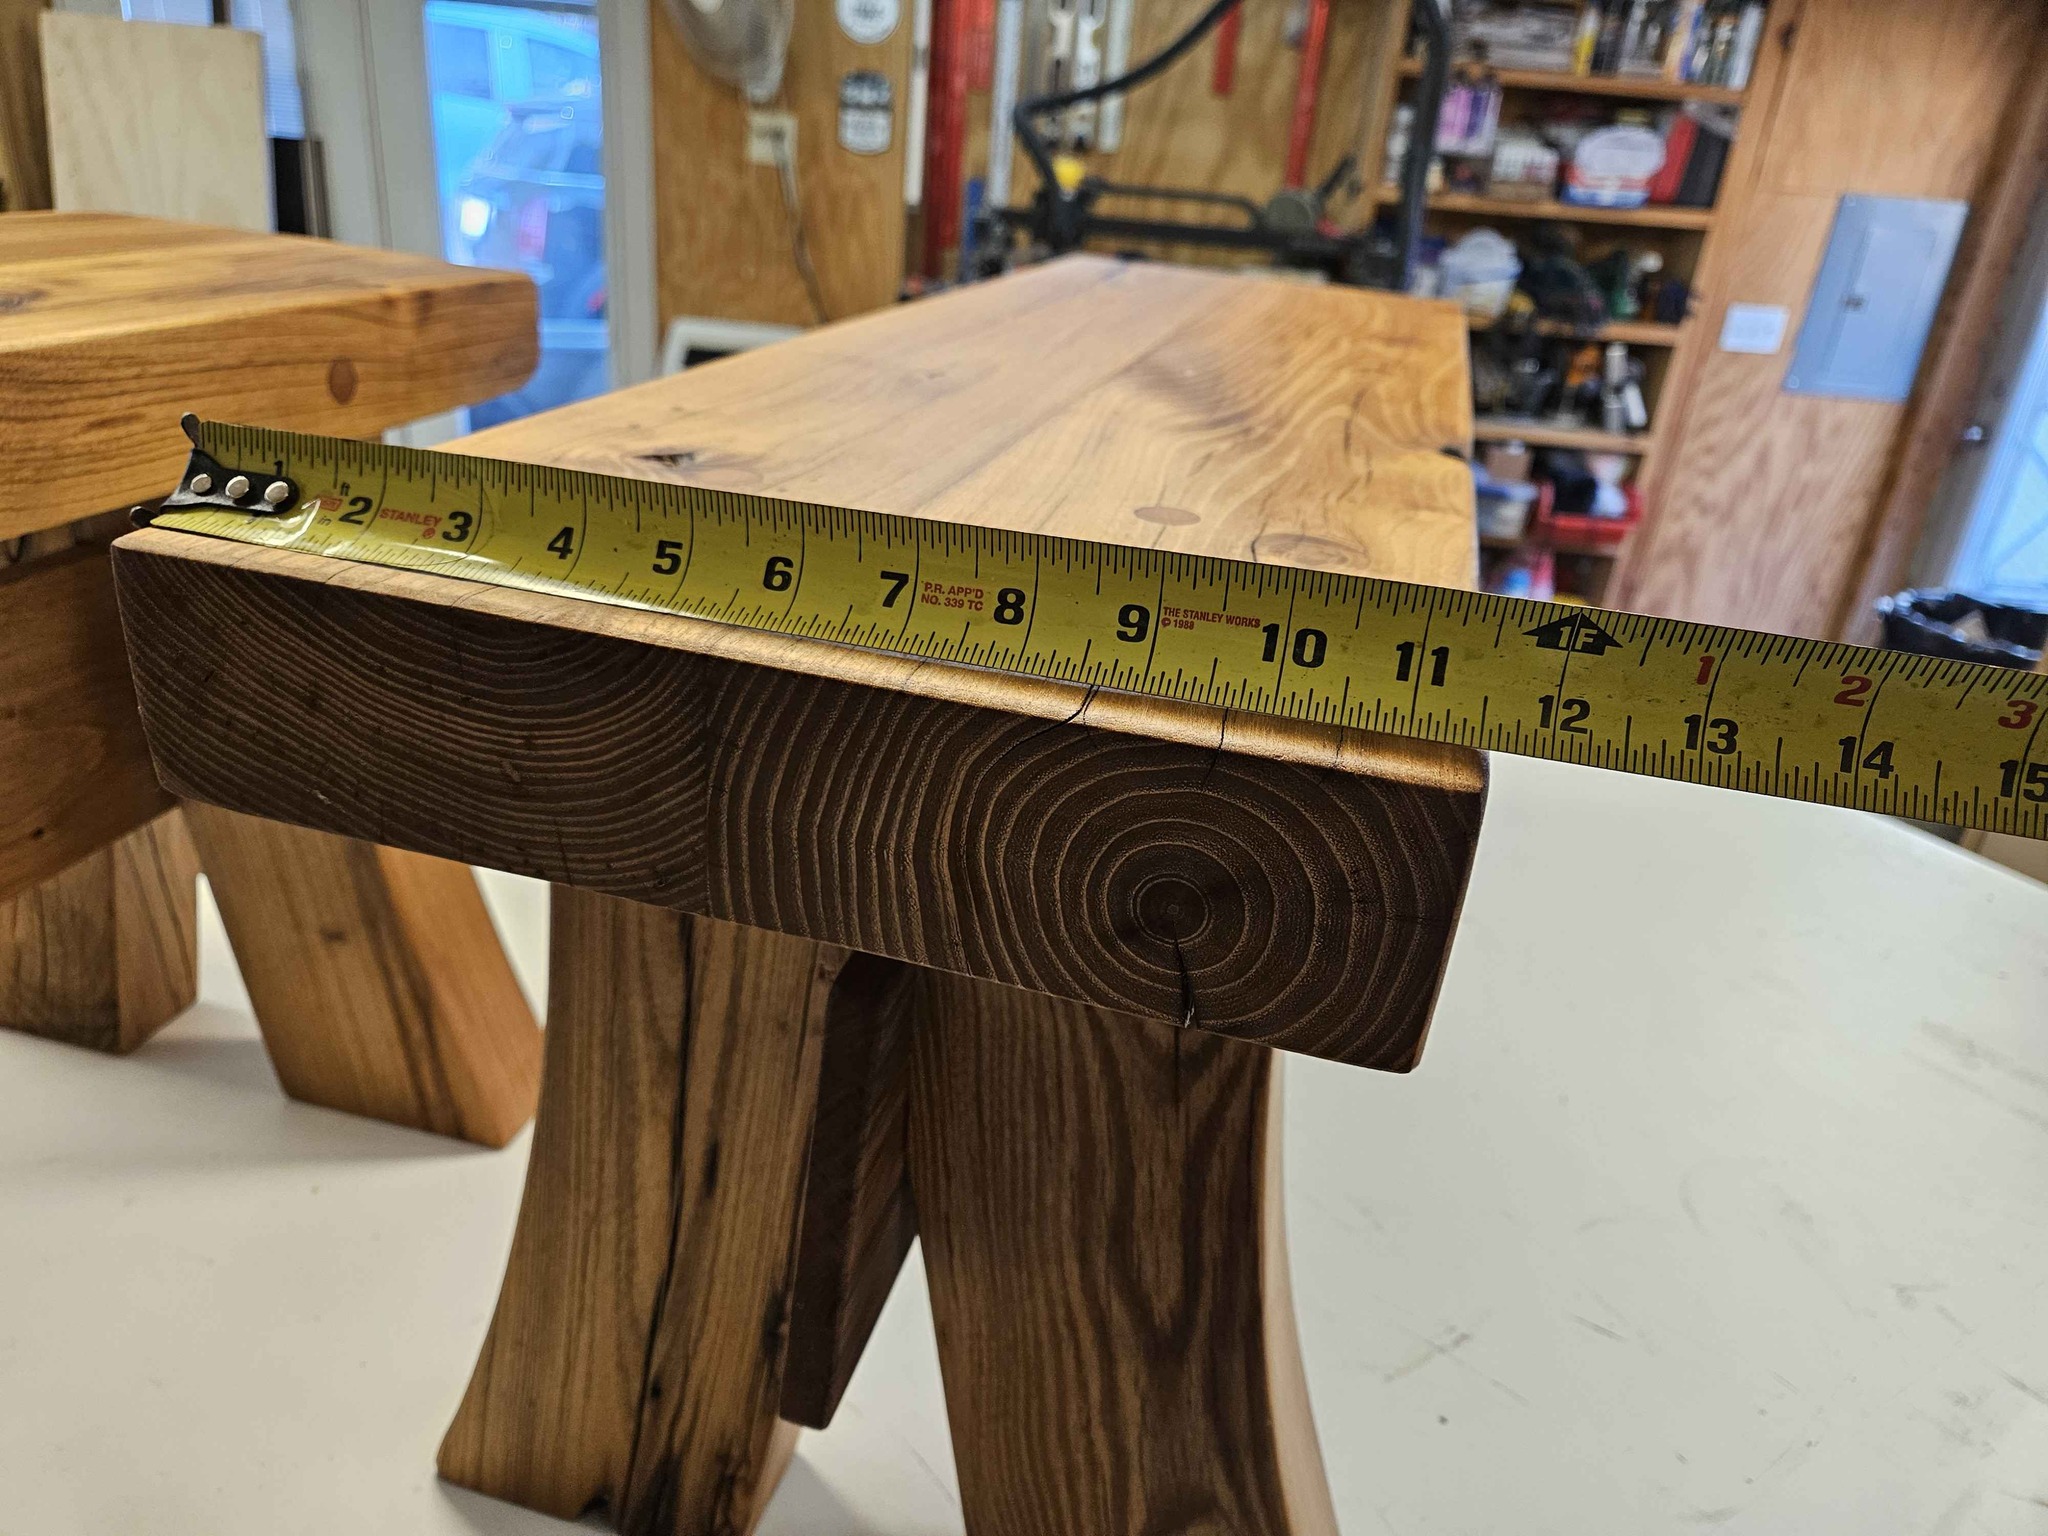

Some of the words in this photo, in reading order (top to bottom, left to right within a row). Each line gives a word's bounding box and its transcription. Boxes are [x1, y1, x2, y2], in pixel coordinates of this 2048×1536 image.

[338, 496, 374, 526] 2
[379, 508, 443, 527] STANLEY
[442, 511, 473, 543] 3
[546, 526, 575, 560] 4
[652, 539, 684, 576] 5
[762, 556, 794, 592] 6
[880, 570, 910, 608] 7
[924, 581, 945, 594] P.R.
[948, 585, 984, 599] APP'D
[921, 593, 941, 605] NO.
[944, 597, 965, 608] 339
[967, 600, 984, 611] TC
[993, 587, 1026, 626] 8
[1163, 606, 1181, 618] THE
[1182, 609, 1224, 623] STANLEY
[1225, 614, 1261, 629] WORKS
[1116, 603, 1151, 643] 9
[1173, 618, 1195, 630] 1988
[1558, 625, 1598, 650] 1F
[1262, 622, 1328, 669] 10
[1395, 640, 1450, 687] 11
[1696, 655, 1715, 685] 1
[1833, 675, 1873, 707] 2
[1538, 694, 1591, 735] 12
[1998, 700, 2039, 730] 3
[1684, 714, 1740, 755] 13
[1838, 735, 1895, 780] 14
